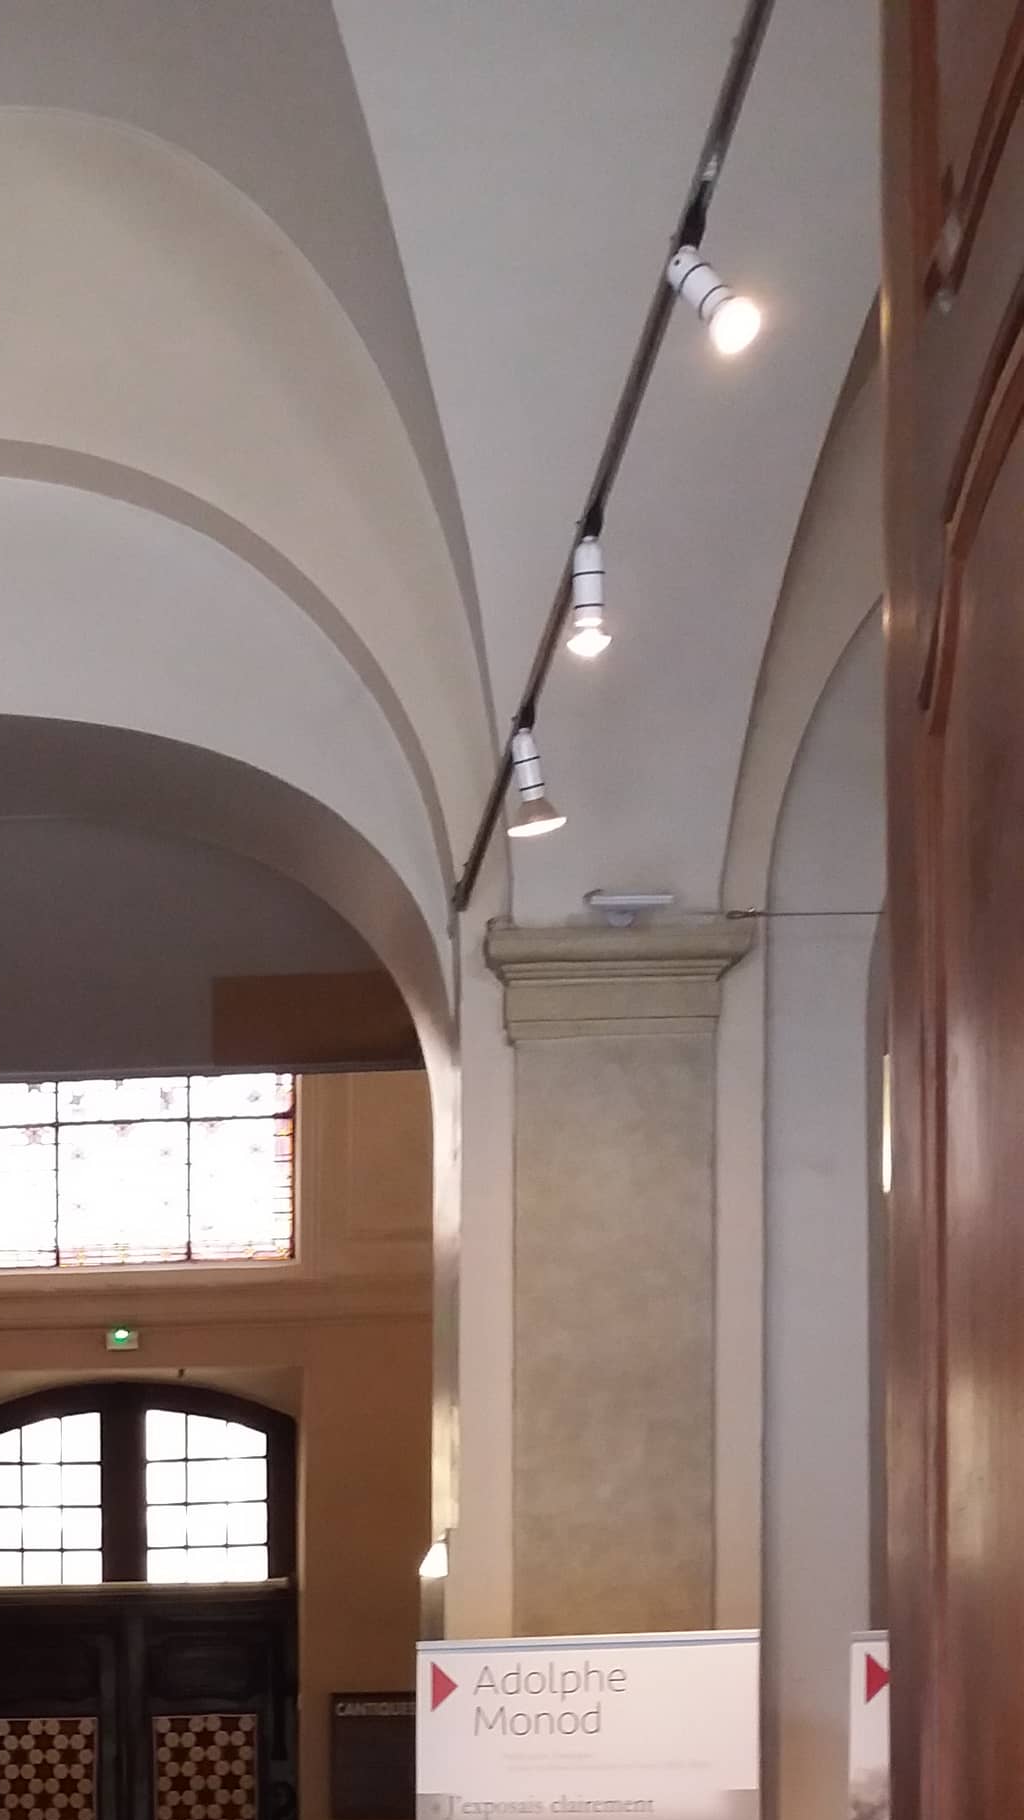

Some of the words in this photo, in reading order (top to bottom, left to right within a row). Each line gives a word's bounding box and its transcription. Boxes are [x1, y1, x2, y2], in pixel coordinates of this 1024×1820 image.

[473, 1660, 628, 1701] Adolphe
[473, 1702, 602, 1737] Monod
[445, 1796, 545, 1820] J'exposais
[551, 1795, 655, 1814] clairement
